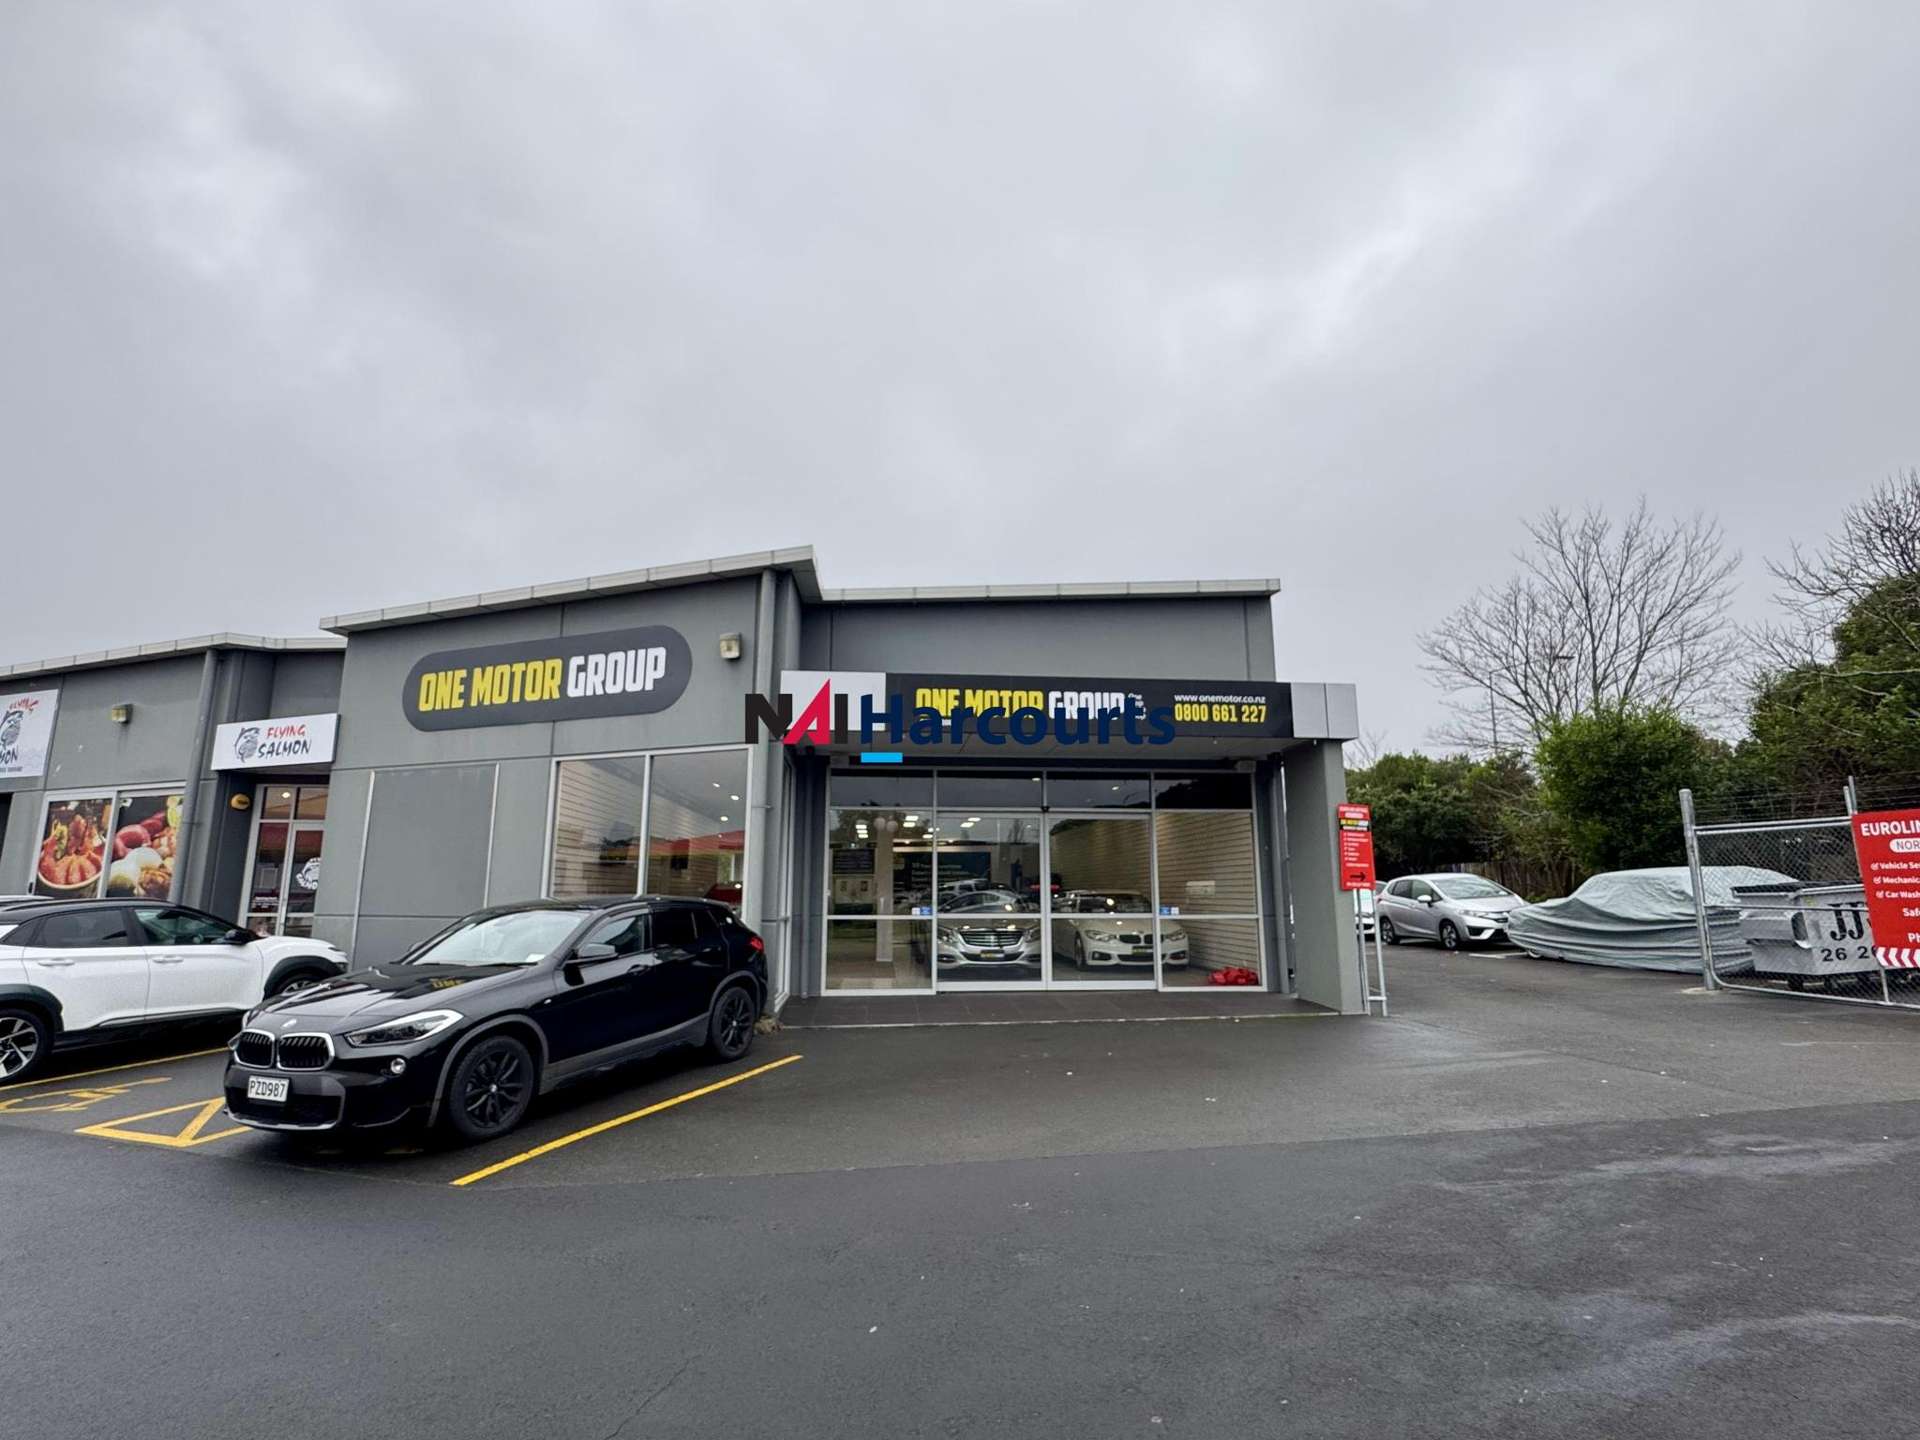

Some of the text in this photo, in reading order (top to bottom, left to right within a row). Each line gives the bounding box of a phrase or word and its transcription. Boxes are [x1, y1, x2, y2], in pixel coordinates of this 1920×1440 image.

[418, 647, 666, 712] ONE MOTOR GROUP
[1174, 694, 1266, 704] www.onemotor.co.nz
[1174, 703, 1267, 723] 0800 661 227
[266, 725, 306, 738] FLYING
[258, 739, 312, 759] SALMON
[1880, 861, 1908, 870] Vehicle
[1821, 947, 1848, 962] 26
[250, 1080, 286, 1098] PZD987
